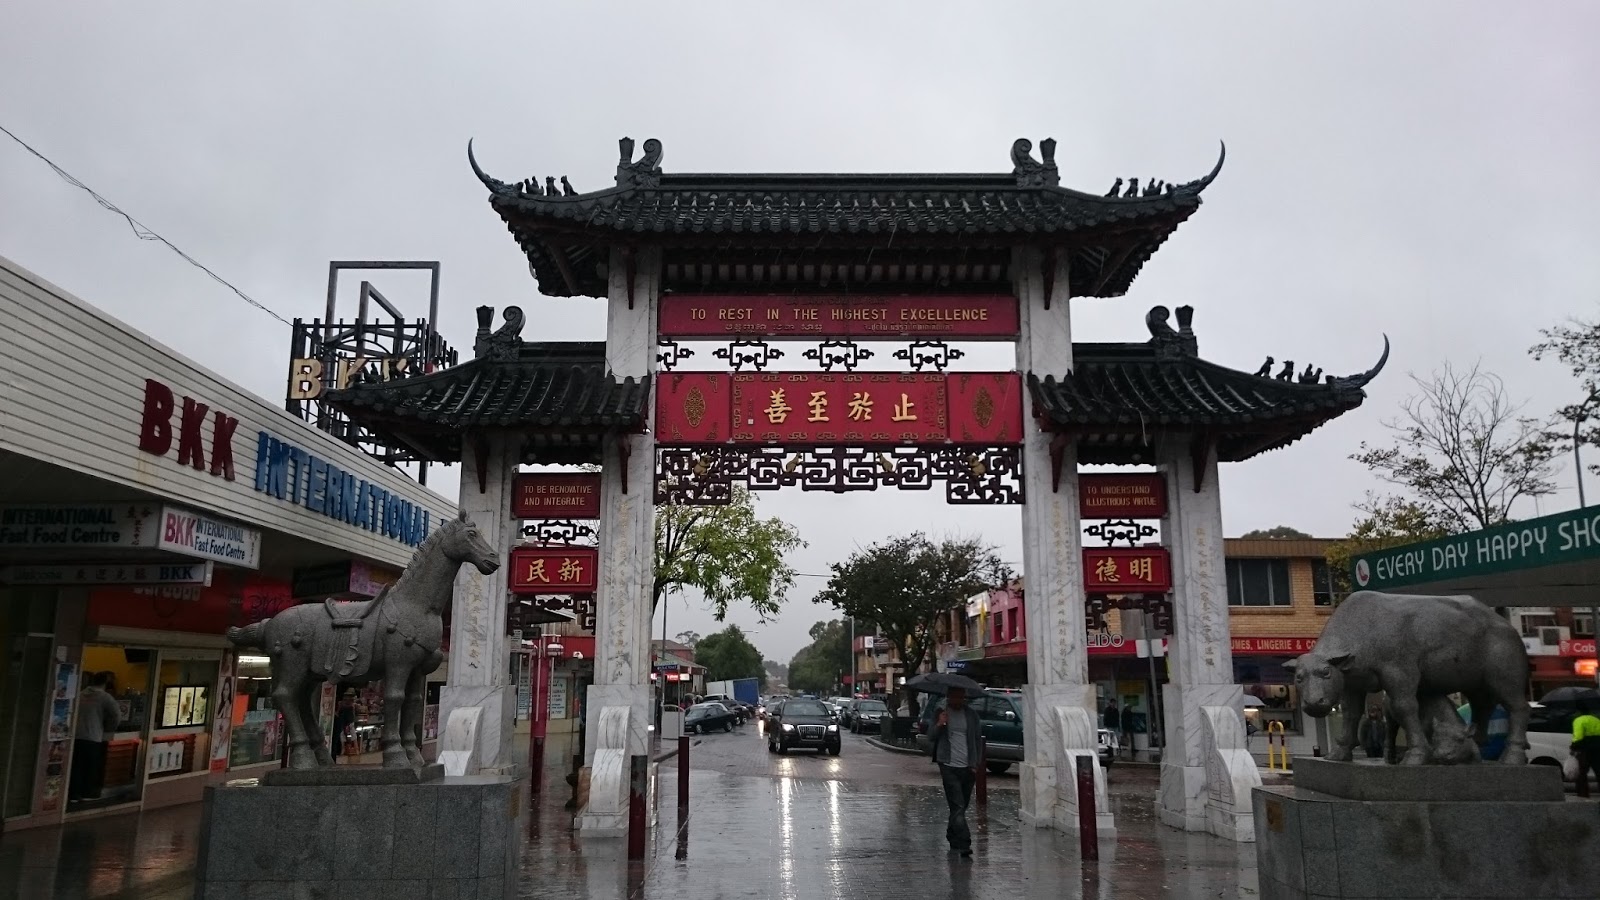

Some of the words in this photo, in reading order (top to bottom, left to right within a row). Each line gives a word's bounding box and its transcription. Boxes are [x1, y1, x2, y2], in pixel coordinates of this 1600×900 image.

[690, 309, 706, 320] TO
[719, 309, 753, 320] REST
[767, 309, 779, 320] IN
[793, 309, 818, 320] THE
[831, 309, 887, 320] HIGHEST
[900, 309, 988, 320] EXCELLENCE
[139, 378, 239, 481] BKK
[524, 485, 534, 494] TO
[536, 485, 547, 494] BE
[549, 485, 592, 494] RENOVATIVE
[1087, 486, 1097, 494] TO
[1100, 485, 1150, 494] UNDERSTAND
[524, 497, 540, 505] AND
[543, 497, 585, 505] INTEGRATE
[1086, 497, 1131, 506] ILLUSTRIOUS
[1133, 496, 1157, 506] VIRTUE
[2, 508, 116, 525] INTERNATIONAL
[33, 527, 68, 543] Food
[71, 527, 121, 543] Centre
[164, 512, 197, 548] BKK
[195, 518, 245, 543] INTERNATIONAL
[194, 536, 209, 553] Fast
[209, 539, 225, 556] Food
[225, 543, 246, 561] Centre
[1376, 550, 1425, 580] EVERY
[1431, 541, 1470, 571] DAY
[1476, 526, 1548, 564] HAPPY
[159, 566, 194, 580] BKK
[1256, 640, 1292, 650] LINGERIE
[1295, 640, 1302, 650] &
